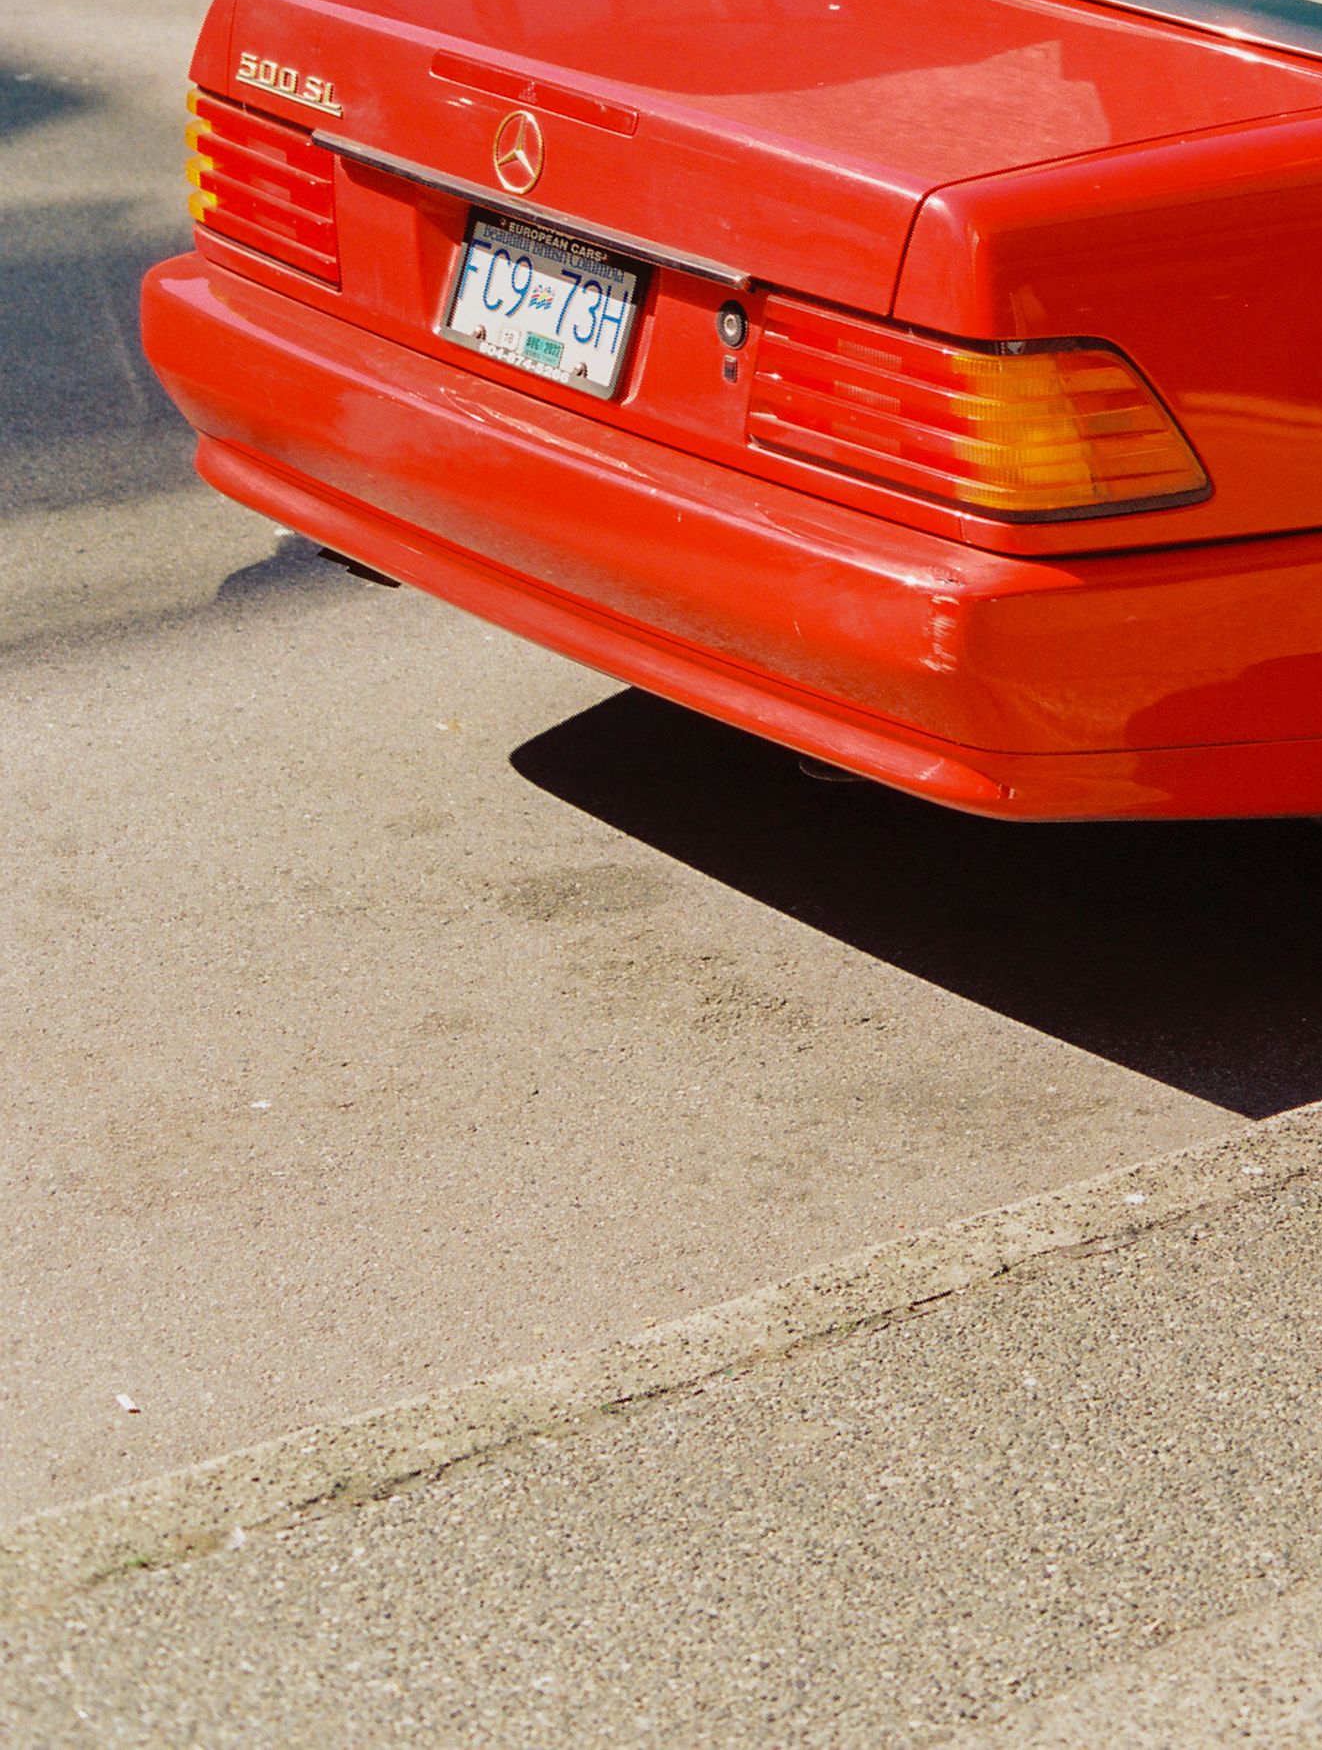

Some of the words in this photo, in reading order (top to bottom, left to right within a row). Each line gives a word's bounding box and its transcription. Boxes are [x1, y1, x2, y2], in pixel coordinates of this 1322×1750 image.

[239, 52, 299, 95] 500
[303, 75, 342, 110] SL
[508, 221, 570, 252] EUROPEAN
[570, 242, 603, 262] CARS
[458, 238, 534, 318] FC9
[555, 268, 629, 355] 73H
